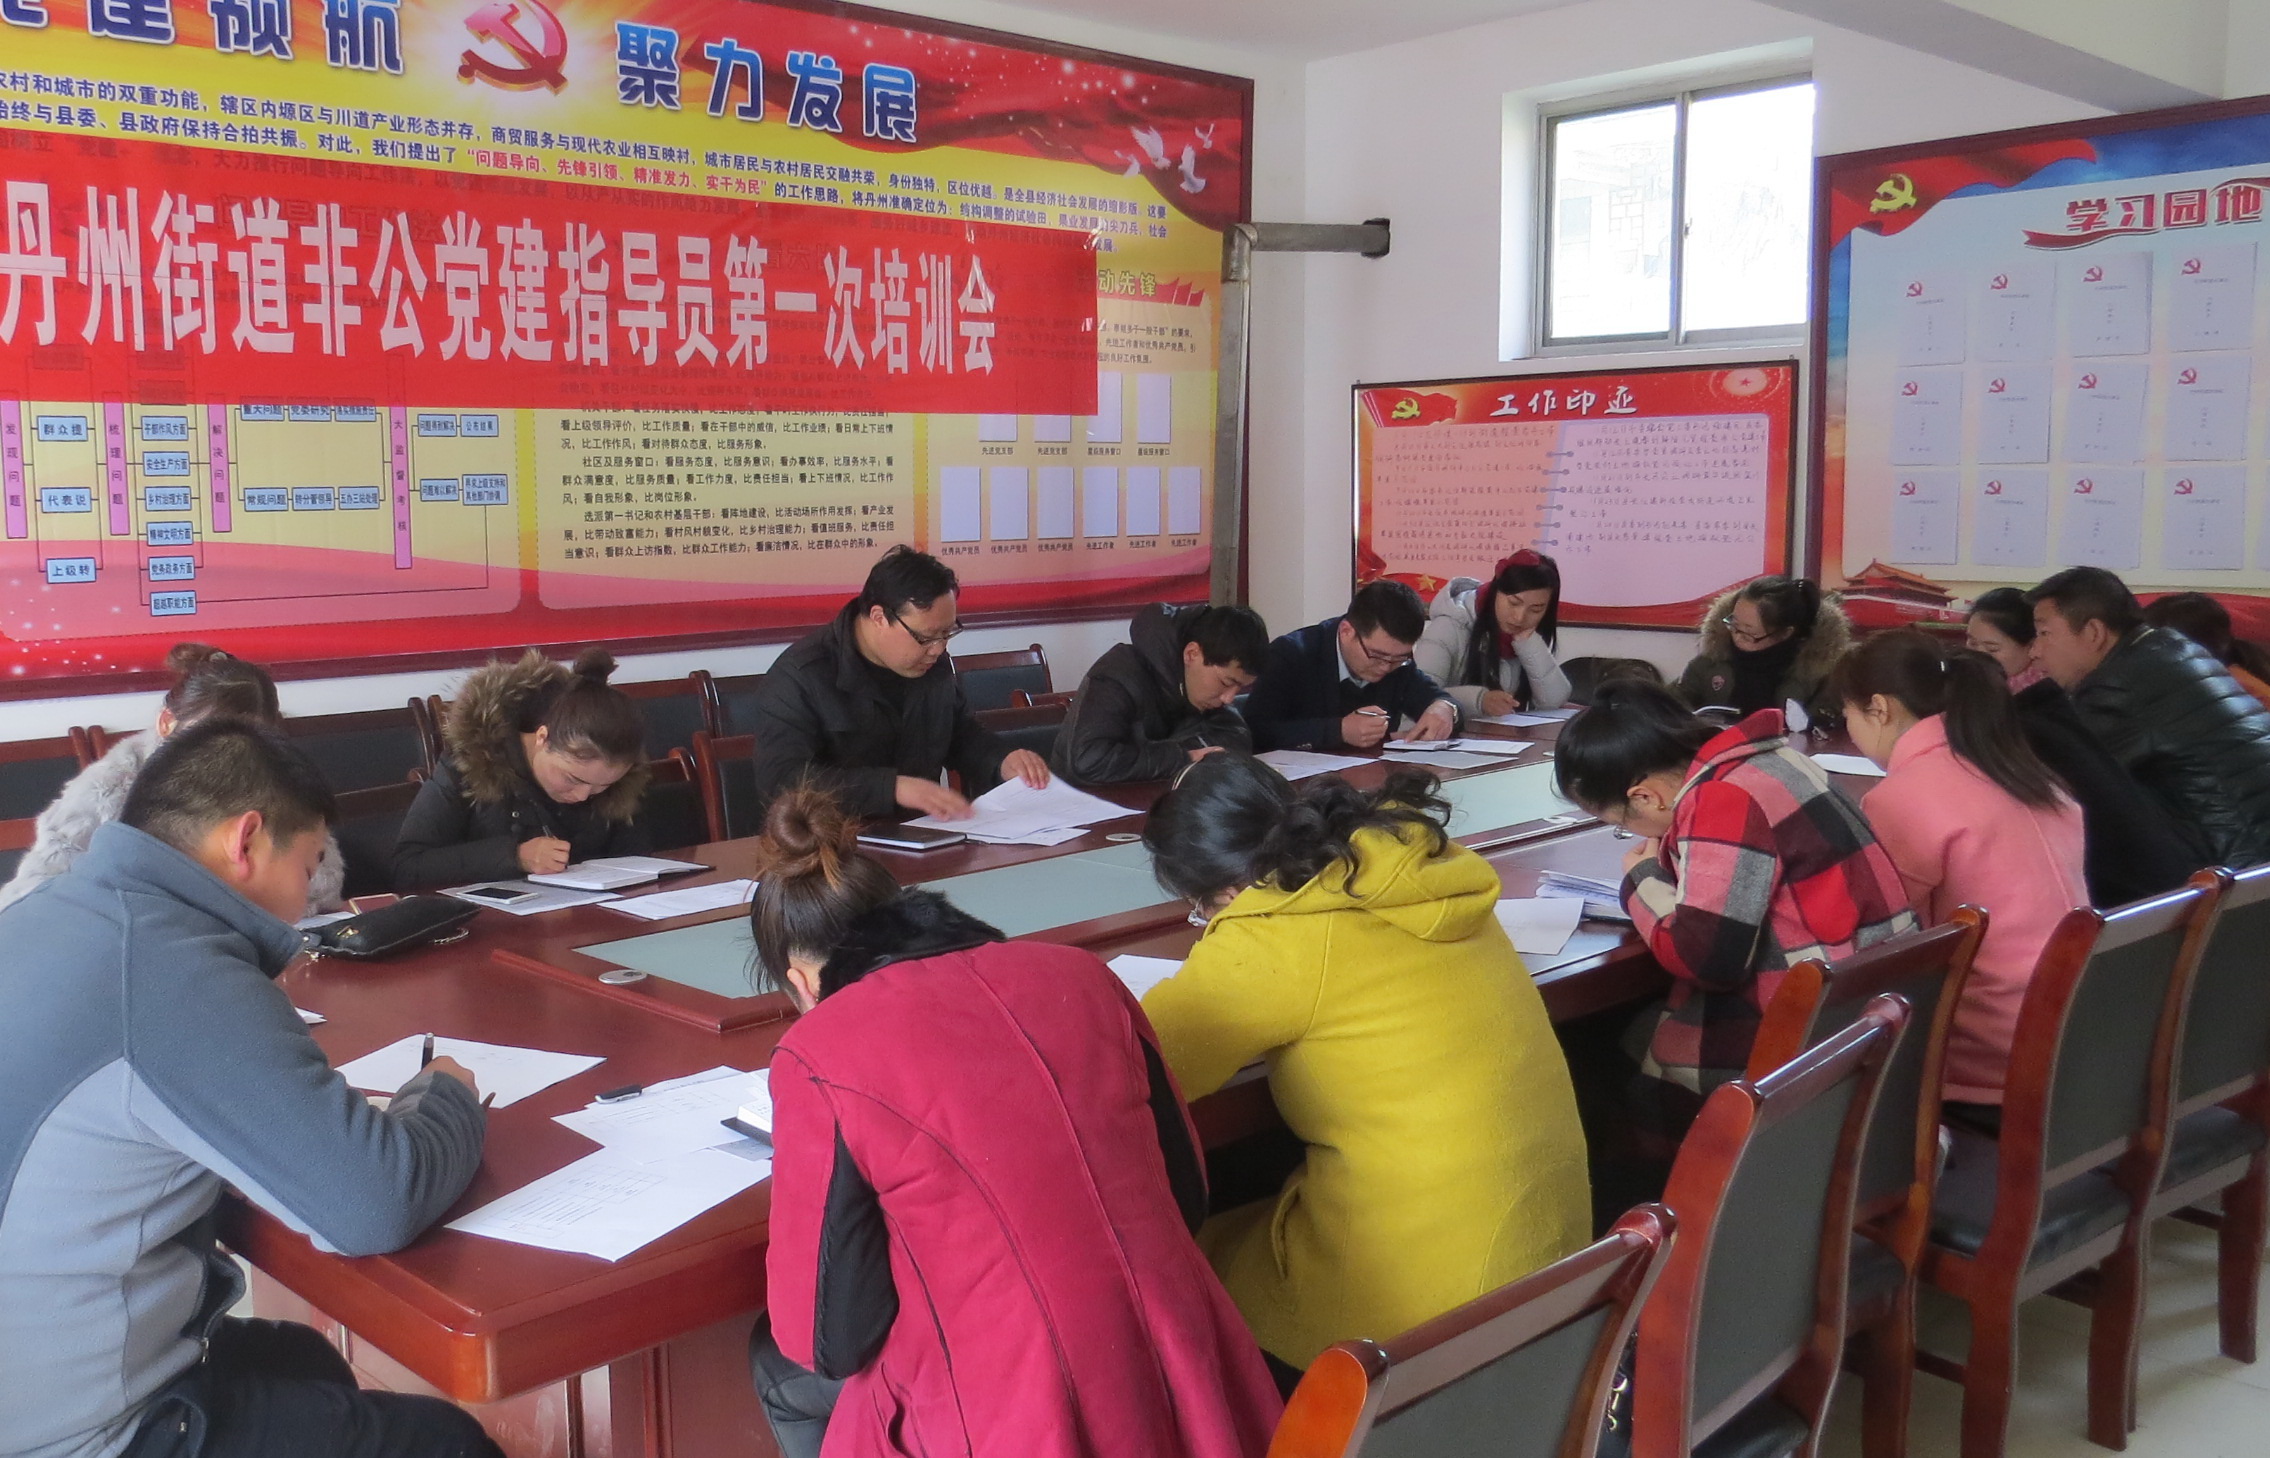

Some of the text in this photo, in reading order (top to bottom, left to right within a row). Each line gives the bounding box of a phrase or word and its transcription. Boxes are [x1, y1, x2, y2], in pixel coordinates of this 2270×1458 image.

[0, 0, 917, 143] 领航 聚力发展
[2066, 185, 2262, 232] 学习园地
[0, 181, 996, 377] 丹州街道非公党建指导员第一次培训会
[1489, 385, 1638, 417] 工作印迹
[44, 424, 83, 436] 群众提
[5, 424, 21, 507] 发现问题
[109, 424, 124, 506] 梳理问题
[212, 424, 225, 504] 解决问题
[48, 494, 87, 507] 代表说
[247, 494, 286, 505] 常规问题
[52, 566, 90, 577] 上级转
